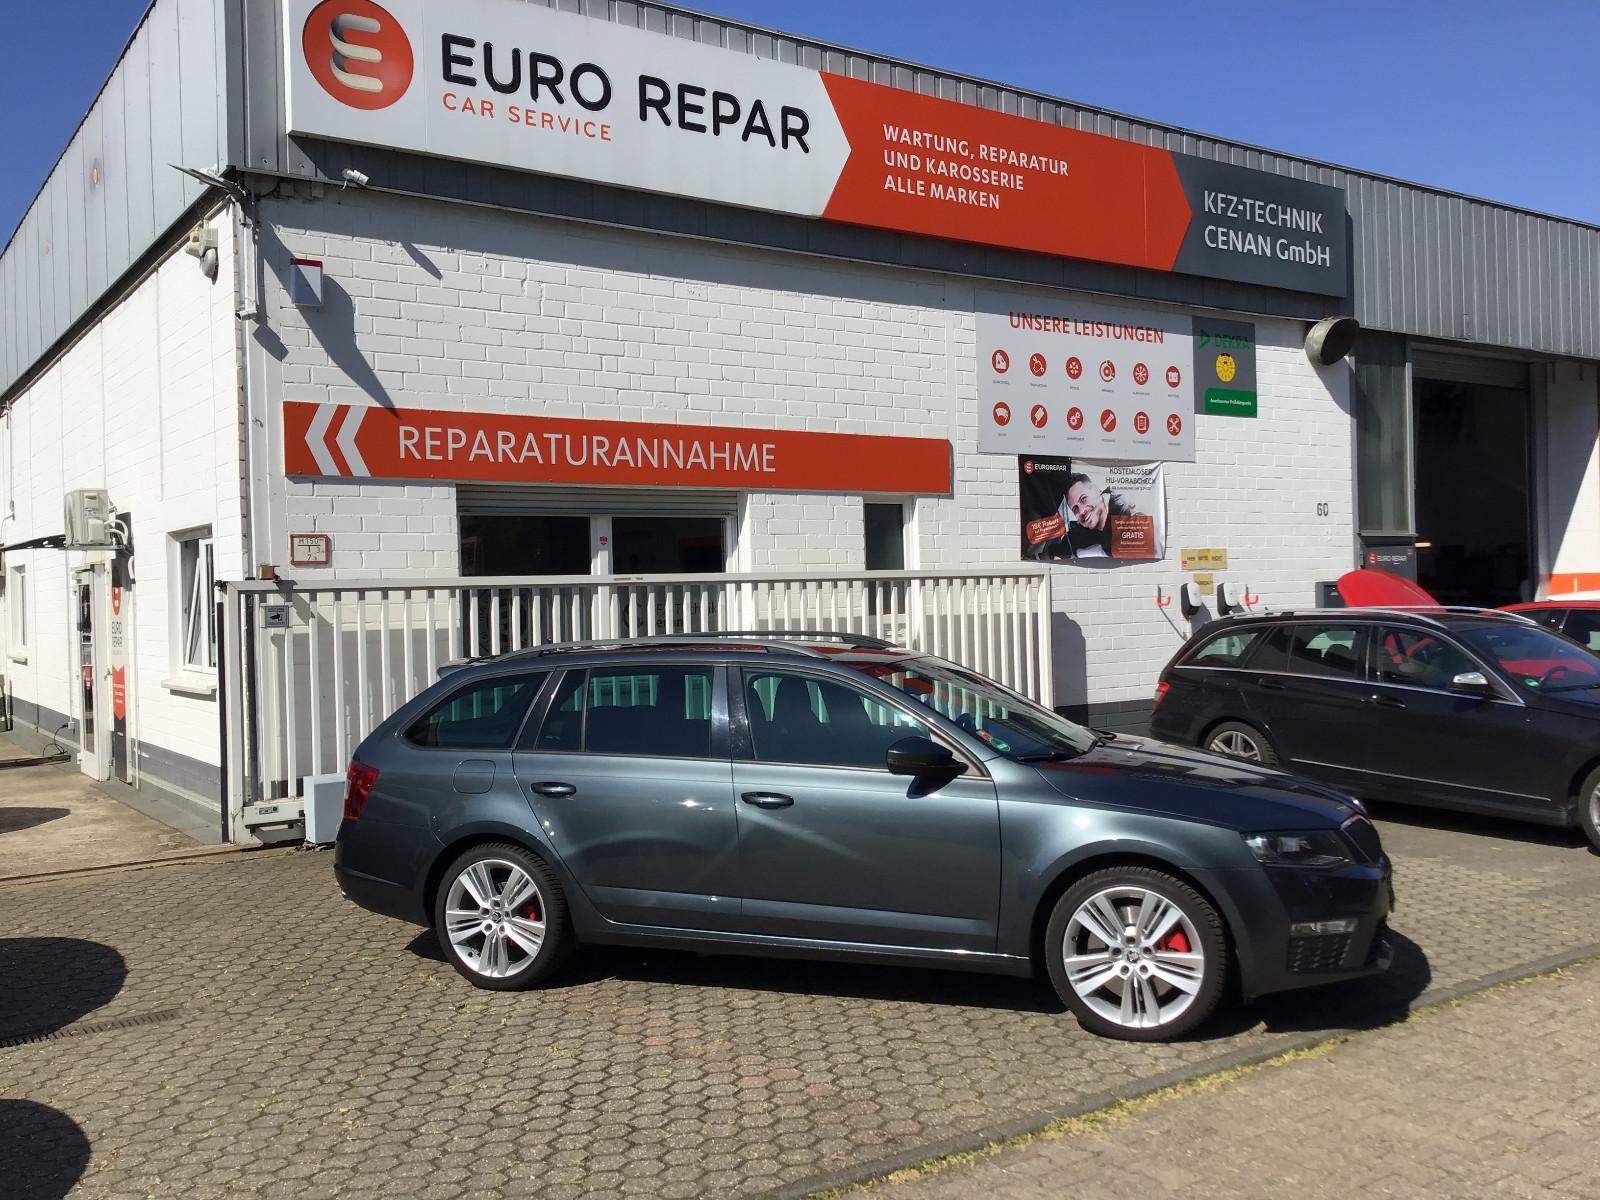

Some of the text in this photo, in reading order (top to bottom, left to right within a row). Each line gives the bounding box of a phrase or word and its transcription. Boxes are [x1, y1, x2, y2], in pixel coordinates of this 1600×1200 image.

[441, 32, 811, 154] EURO REPAR
[443, 92, 612, 142] CAR SERVICE
[883, 124, 1069, 177] WARTUNG, REPARATUR
[884, 149, 1024, 191] UND KAROSSERIE
[884, 174, 1000, 210] ALLE MARKEN
[1204, 190, 1324, 234] KFZ-TECHNIK
[1204, 225, 1331, 268] CENAN GmbH
[1009, 311, 1164, 344] UNSERE LEISTUNGEN
[398, 425, 776, 473] REPARATURANNAHME
[1034, 463, 1067, 471] EUROREPAR
[1110, 467, 1153, 476] KOSTENLOSER
[1316, 502, 1329, 516] 60
[1121, 531, 1144, 539] GRATIS
